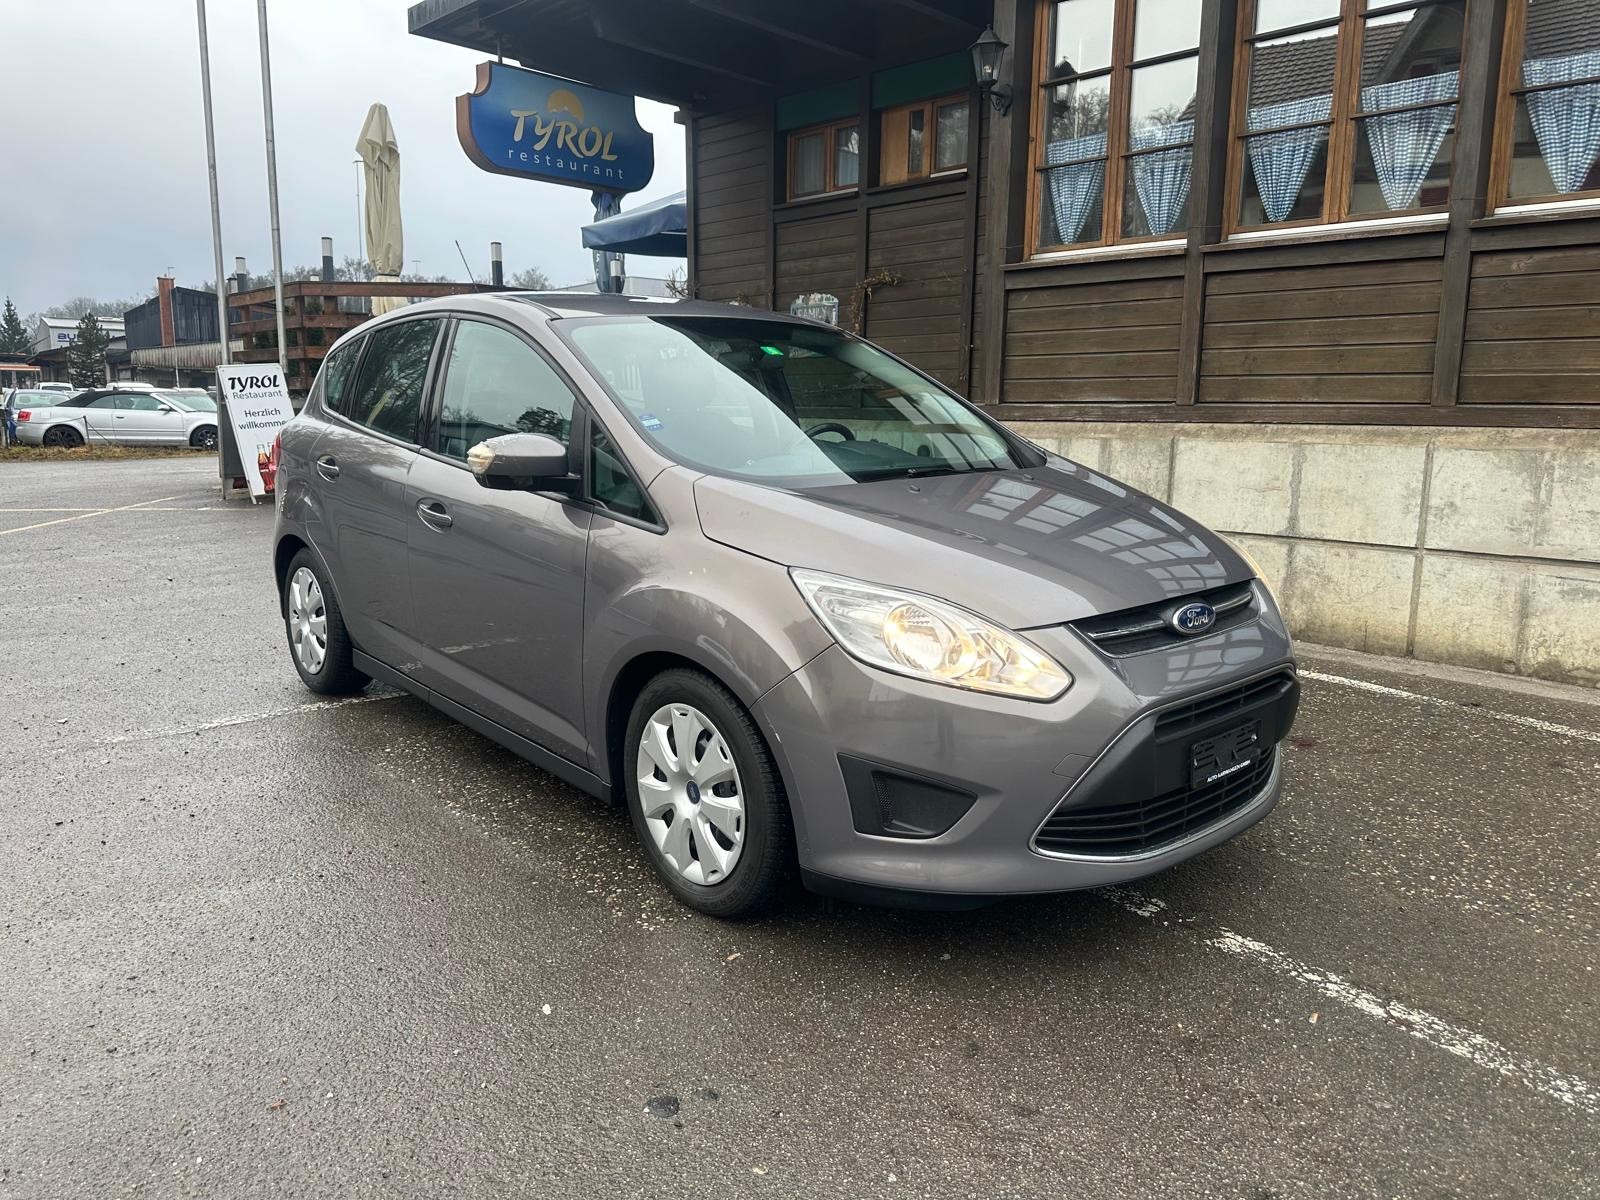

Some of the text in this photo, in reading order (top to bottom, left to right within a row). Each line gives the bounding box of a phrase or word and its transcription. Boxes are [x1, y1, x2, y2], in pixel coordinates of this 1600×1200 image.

[511, 110, 618, 160] TYROL
[508, 149, 624, 180] restaurant
[228, 375, 280, 393] TYROL
[233, 391, 283, 400] Restaurant
[244, 408, 281, 418] Herzlich
[1187, 608, 1209, 627] Ford
